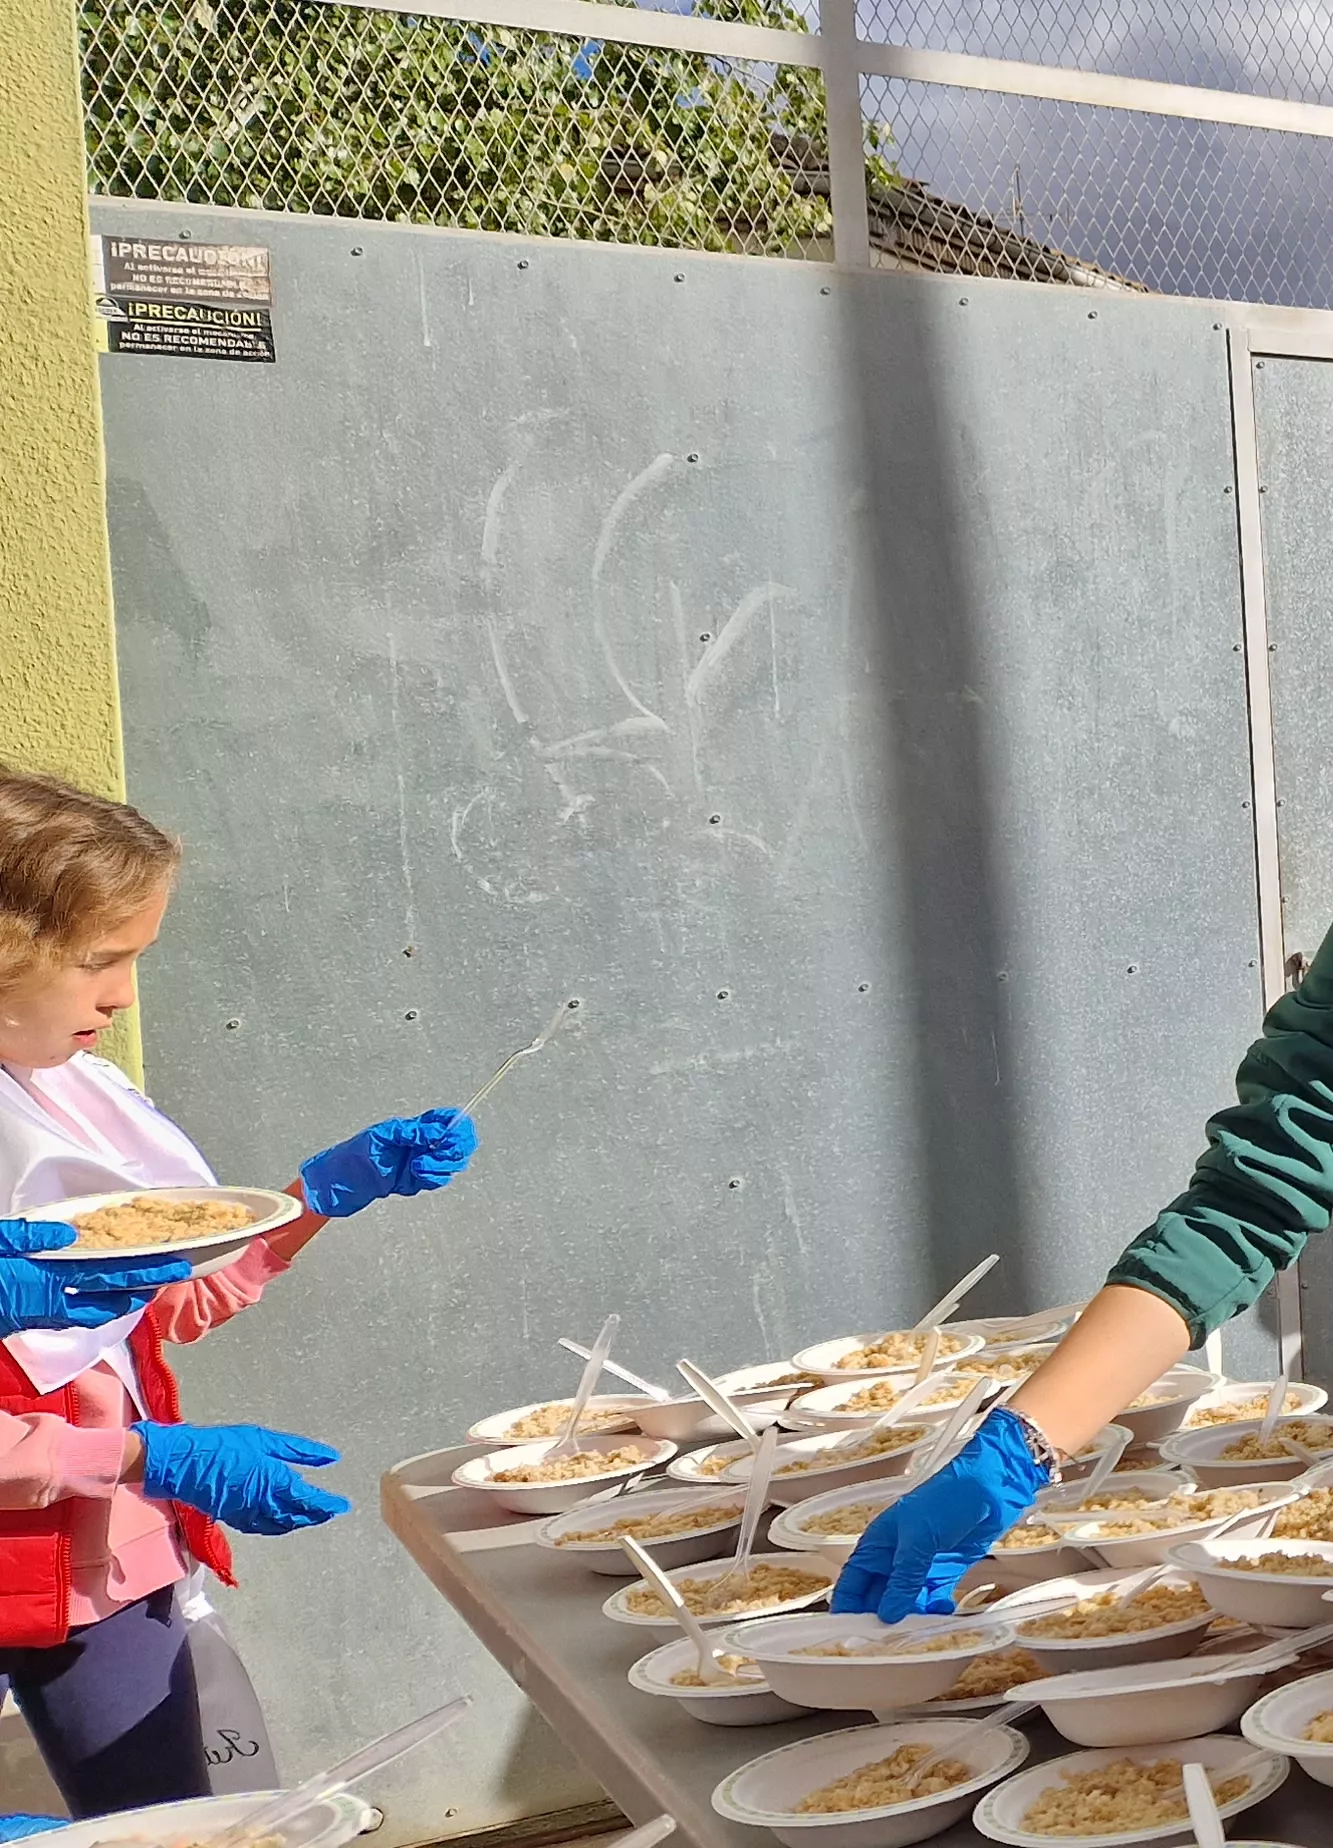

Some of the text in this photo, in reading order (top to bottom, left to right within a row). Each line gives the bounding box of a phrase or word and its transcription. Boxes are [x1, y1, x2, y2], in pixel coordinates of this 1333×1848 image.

[132, 273, 147, 283] NO
[121, 331, 140, 341] NO
[144, 333, 161, 342] ES
